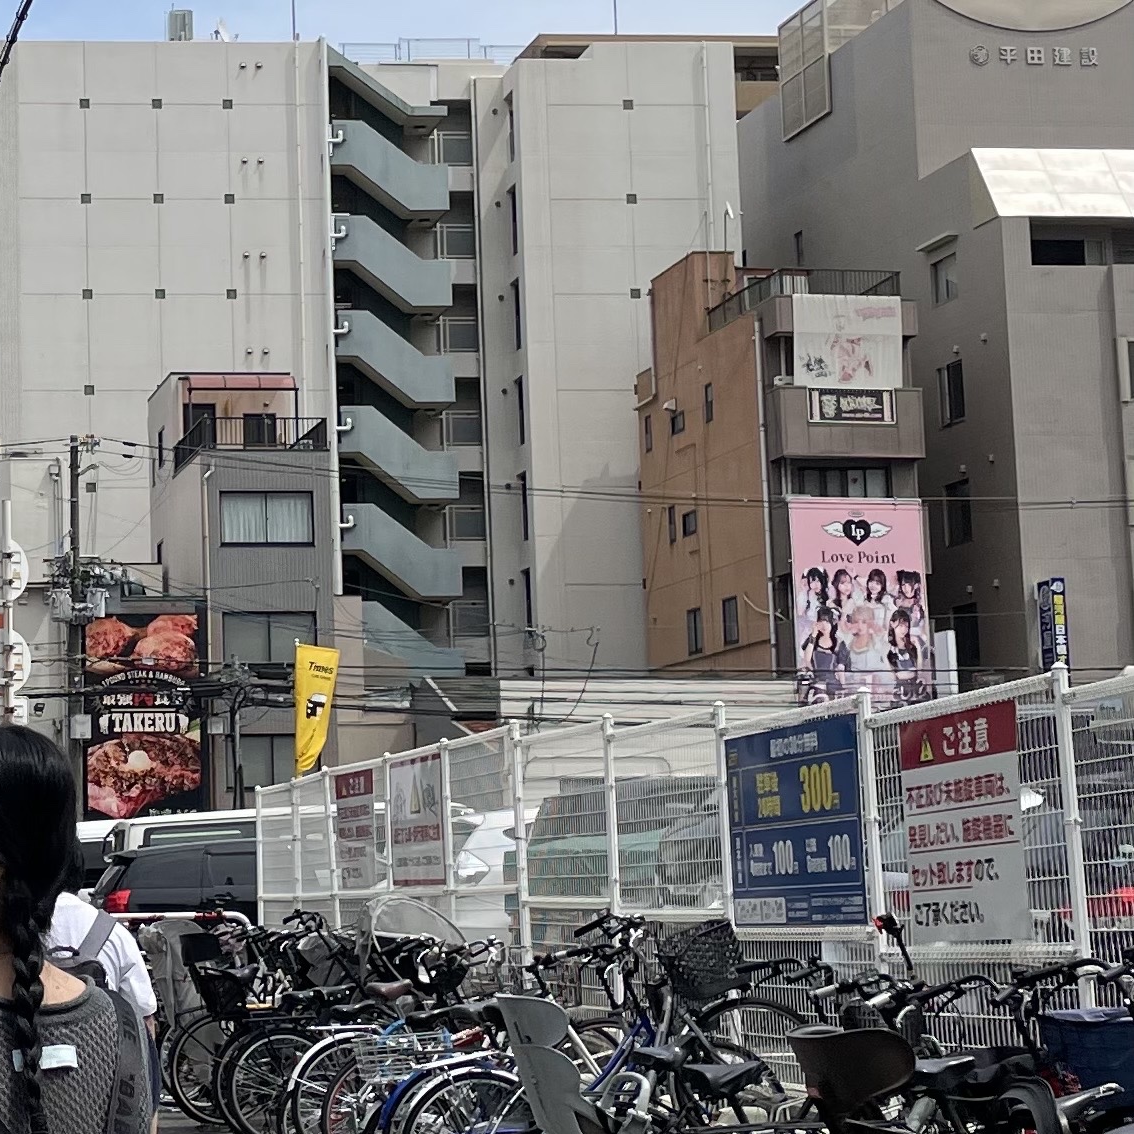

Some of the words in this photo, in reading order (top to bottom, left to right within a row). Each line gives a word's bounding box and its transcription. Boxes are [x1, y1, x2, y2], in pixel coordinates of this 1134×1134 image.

[999, 46, 1098, 66] 平田建設
[821, 551, 854, 563] Love
[858, 551, 896, 564] Point
[127, 670, 147, 680] STEAK
[112, 713, 176, 732] TAKERU
[943, 718, 989, 756] ご注意
[915, 901, 985, 926] ご了承ください。
